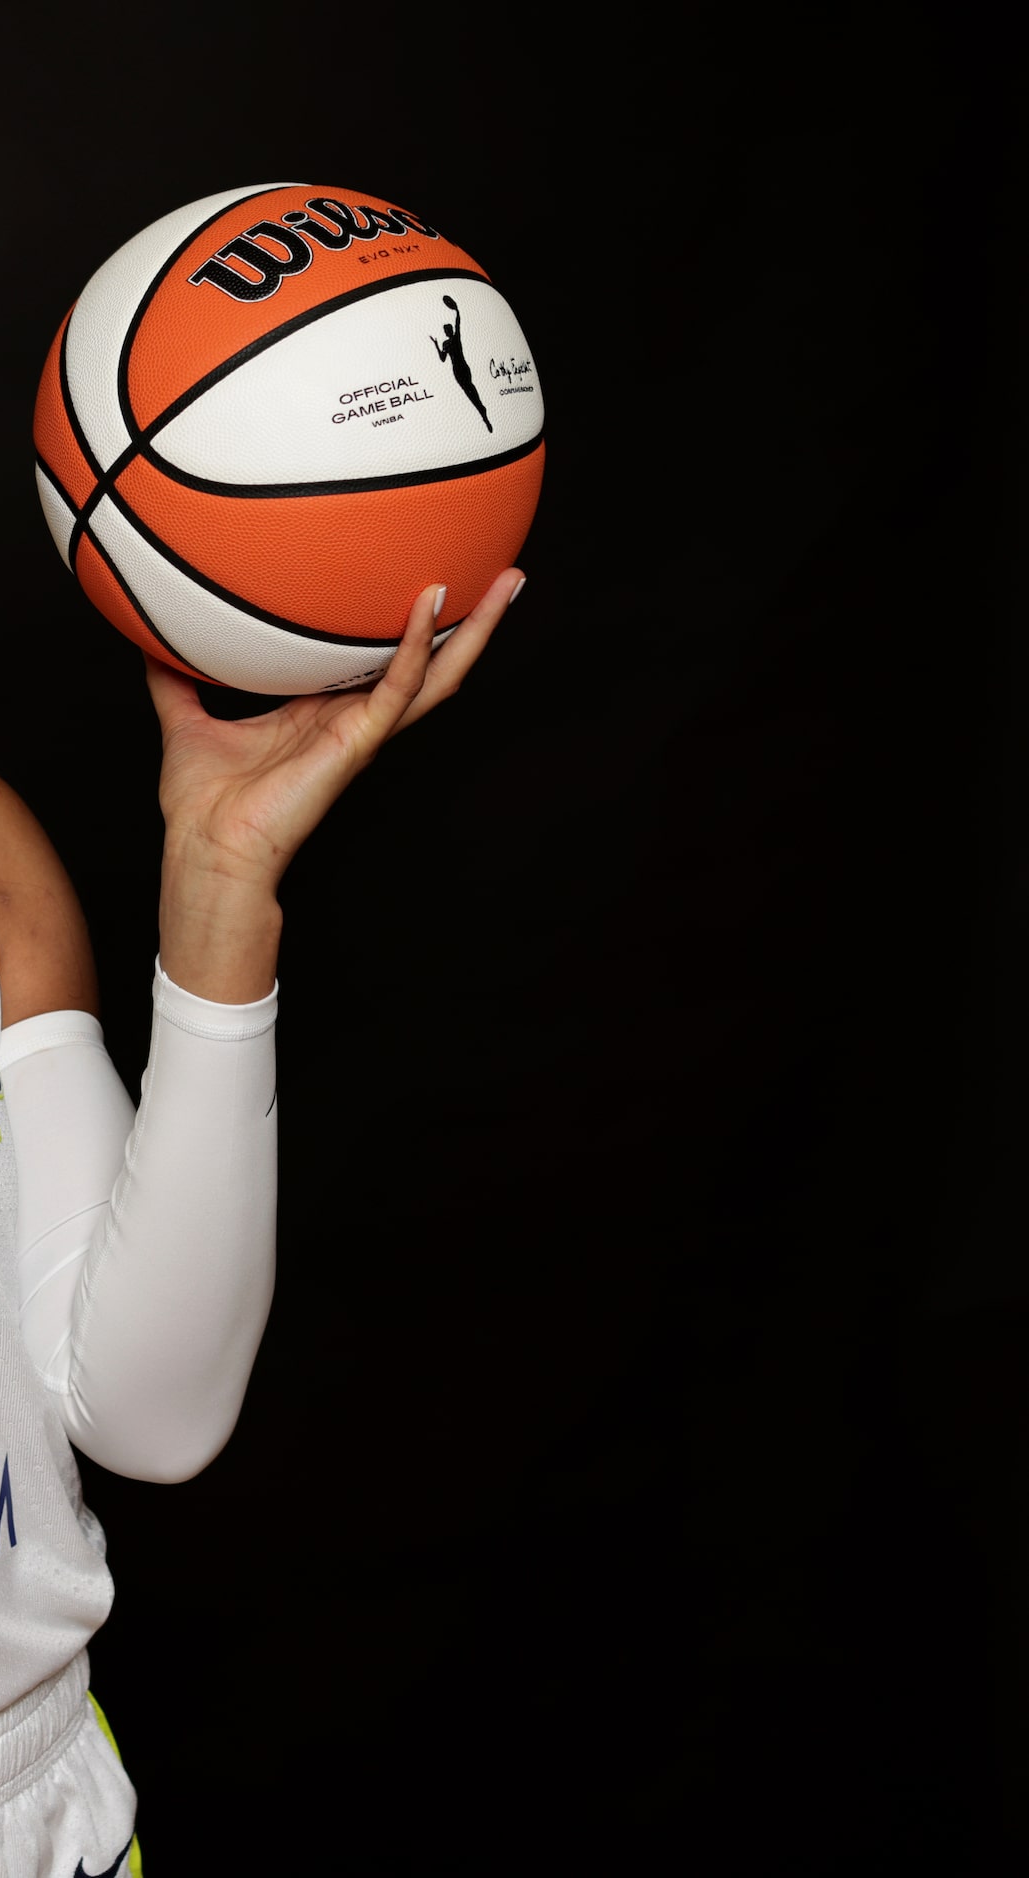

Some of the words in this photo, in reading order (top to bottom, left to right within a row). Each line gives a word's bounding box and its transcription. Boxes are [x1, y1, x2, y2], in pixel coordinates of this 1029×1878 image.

[187, 197, 442, 303] Wilso
[358, 249, 390, 264] EVO
[393, 245, 422, 254] NXT
[339, 376, 419, 404] OFFICIAL
[331, 400, 387, 424] GAME
[389, 389, 434, 408] BALL
[372, 414, 405, 428] WNBA
